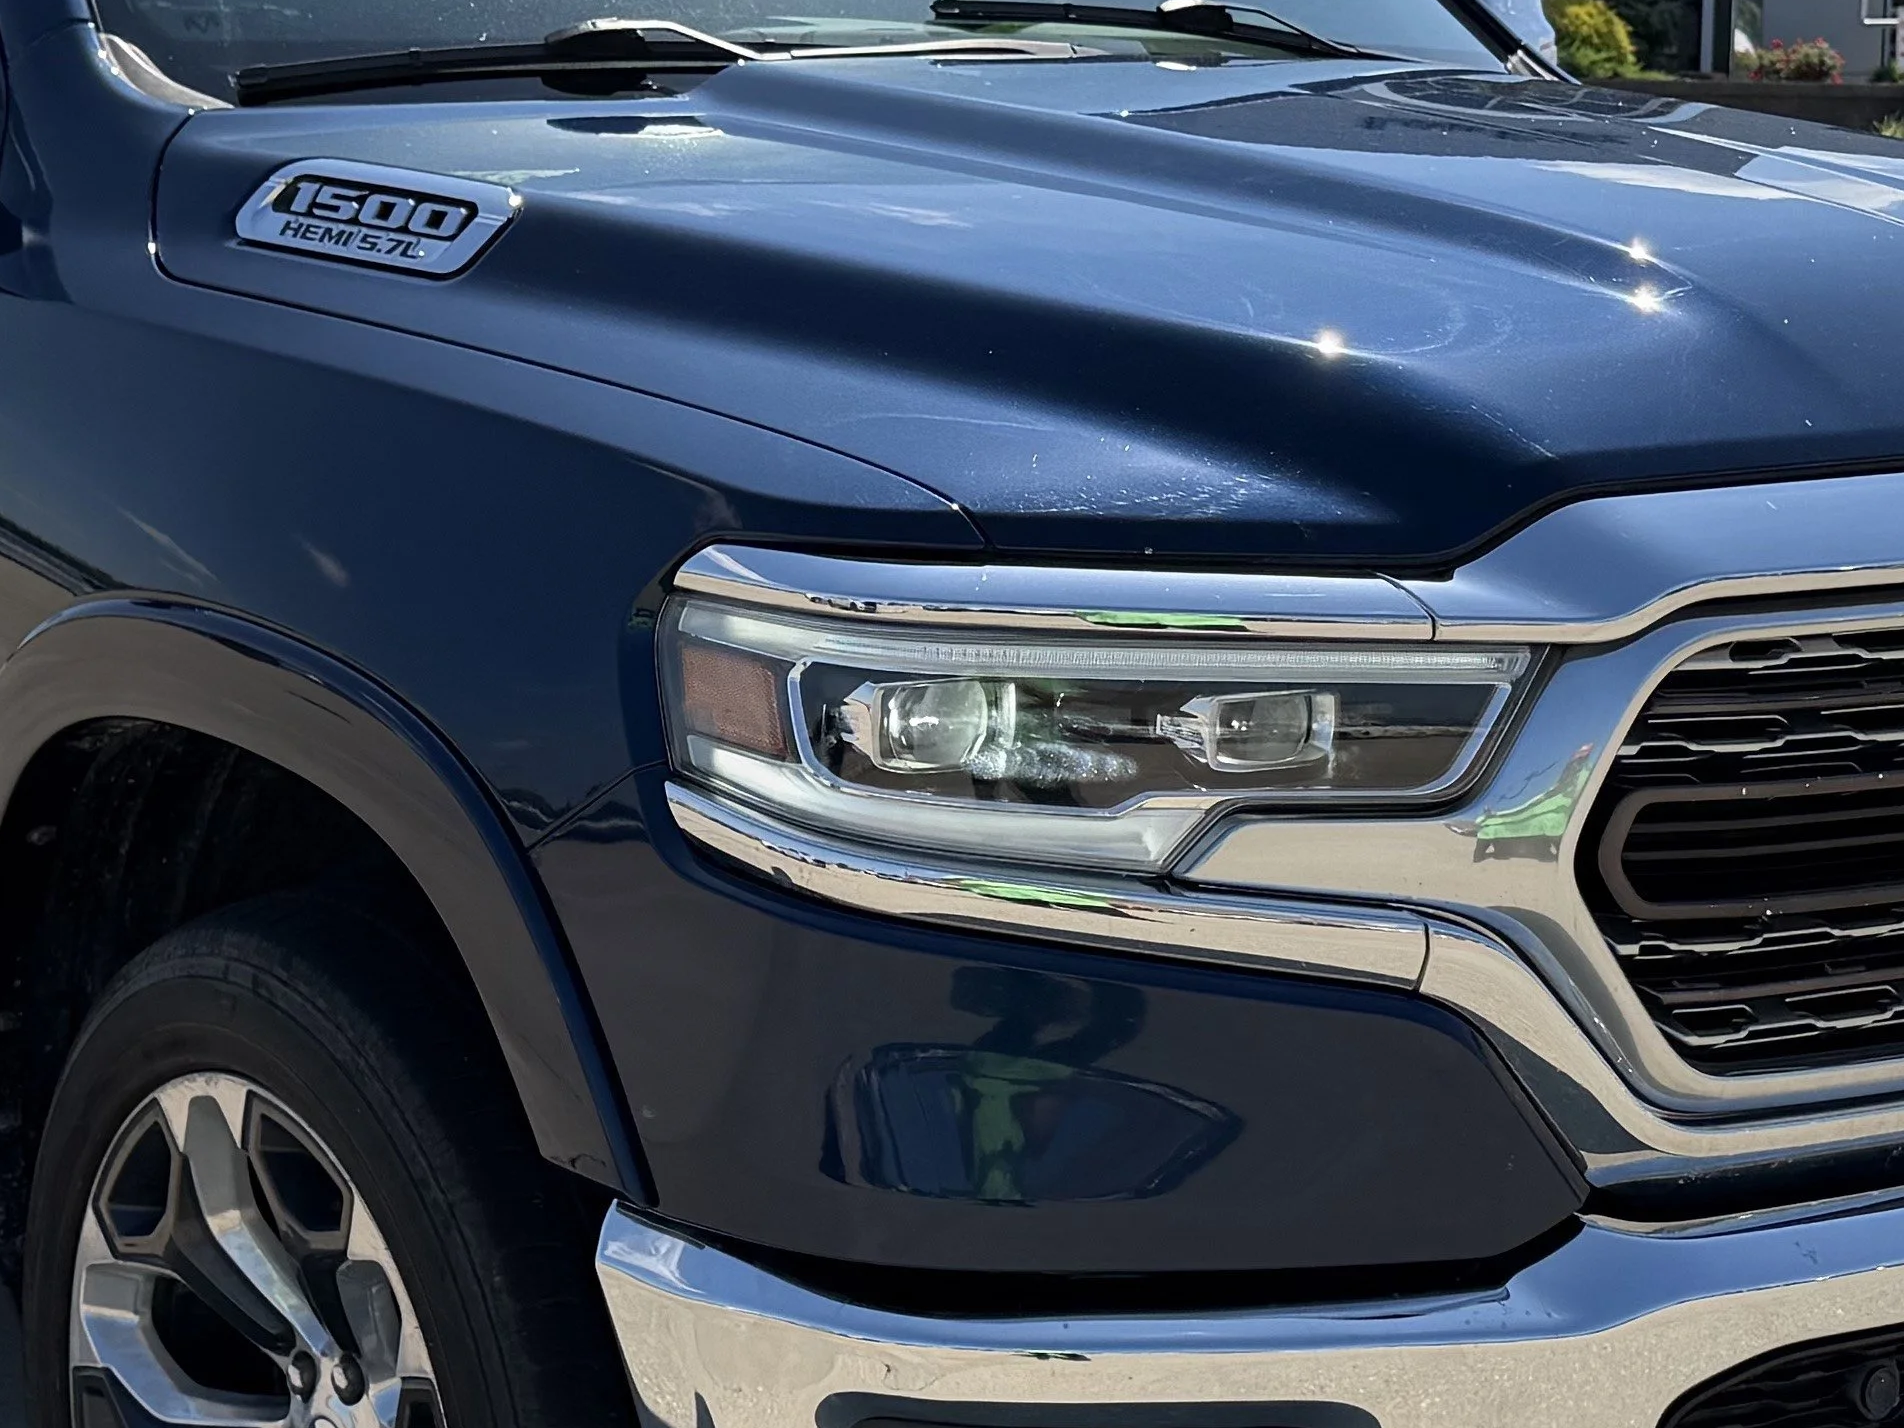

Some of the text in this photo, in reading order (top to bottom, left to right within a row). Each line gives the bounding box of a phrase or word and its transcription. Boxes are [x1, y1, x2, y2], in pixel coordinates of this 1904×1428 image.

[289, 181, 468, 239] 1500
[279, 219, 423, 260] HEMI 5.7L
